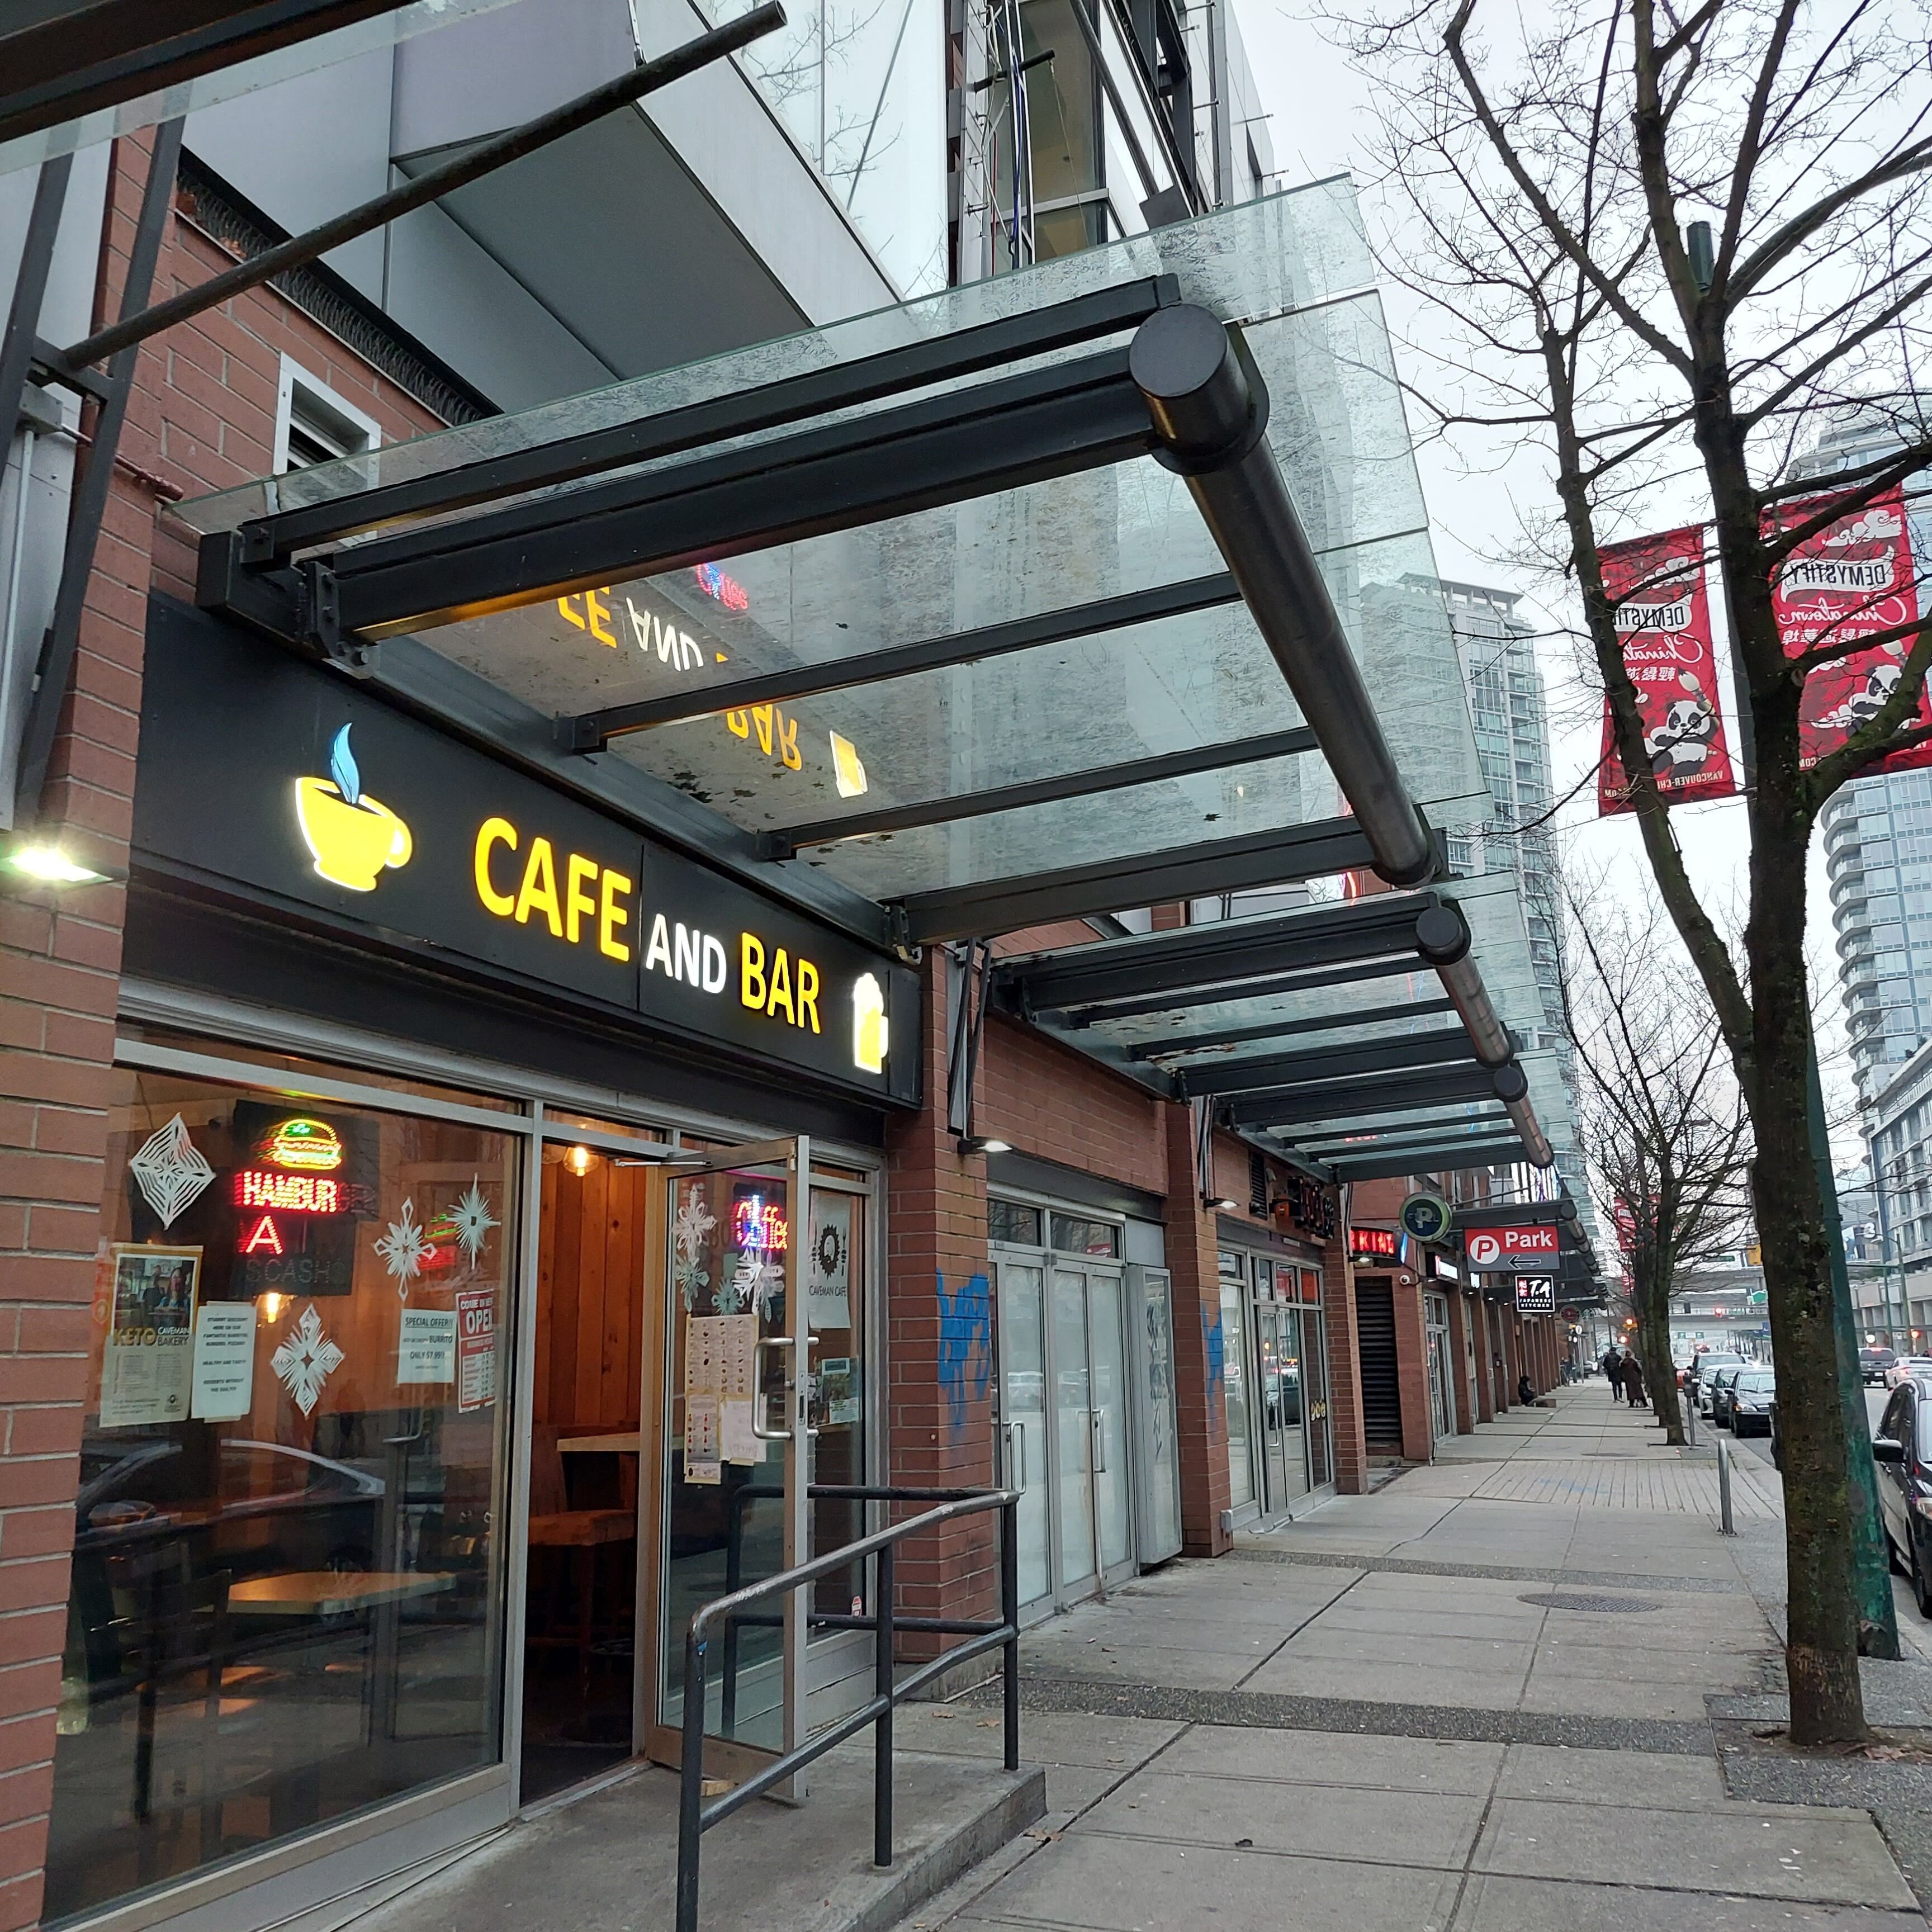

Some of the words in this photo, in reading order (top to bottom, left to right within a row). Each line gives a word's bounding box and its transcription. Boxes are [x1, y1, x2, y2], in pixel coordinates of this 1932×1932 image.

[473, 816, 633, 963] CAFE
[644, 912, 727, 995] AND
[739, 931, 822, 1035] BAR
[1504, 1230, 1554, 1249] Park
[809, 1285, 834, 1296] CAVEMAN
[835, 1286, 847, 1297] CAFE
[1529, 1279, 1551, 1298] T.A
[460, 1299, 479, 1310] COME
[405, 1317, 429, 1327] SPECIAL
[157, 1326, 191, 1336] CAVEMAN
[112, 1327, 158, 1347] KETO
[157, 1336, 190, 1346] BAKERY
[429, 1335, 453, 1343] BURRITO
[410, 1351, 425, 1359] ONLY
